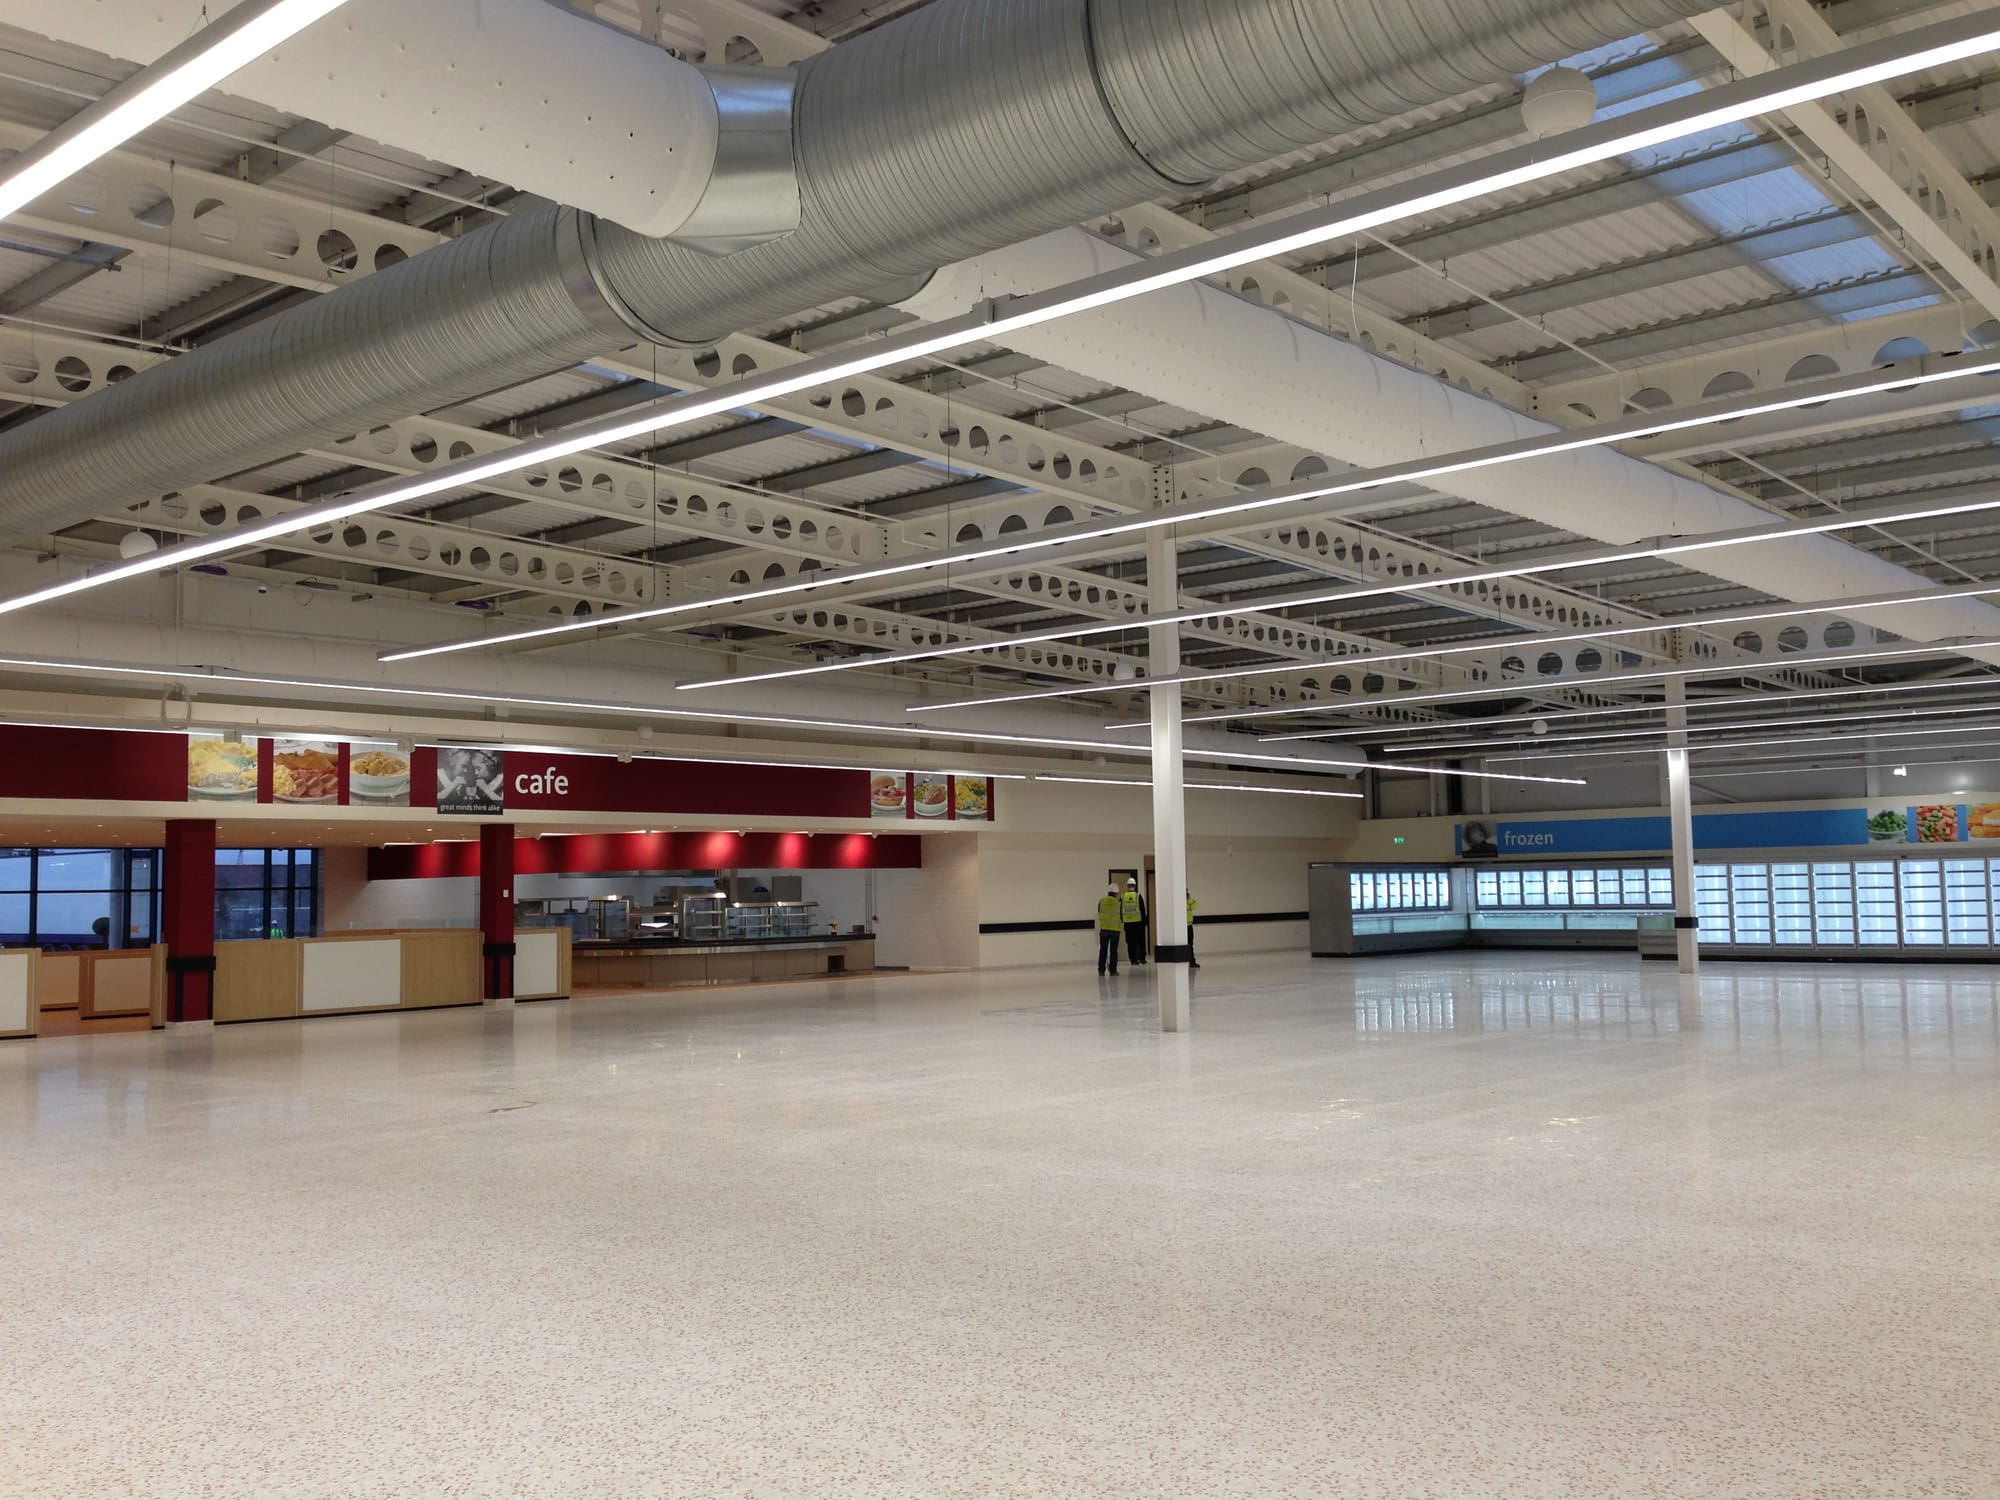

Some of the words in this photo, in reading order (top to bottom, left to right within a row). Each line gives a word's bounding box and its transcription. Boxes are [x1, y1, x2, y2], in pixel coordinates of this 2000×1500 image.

[515, 766, 569, 795] cafe
[440, 804, 455, 812] great
[473, 803, 487, 811] think
[488, 804, 501, 812] alike
[1504, 830, 1554, 846] frozen
